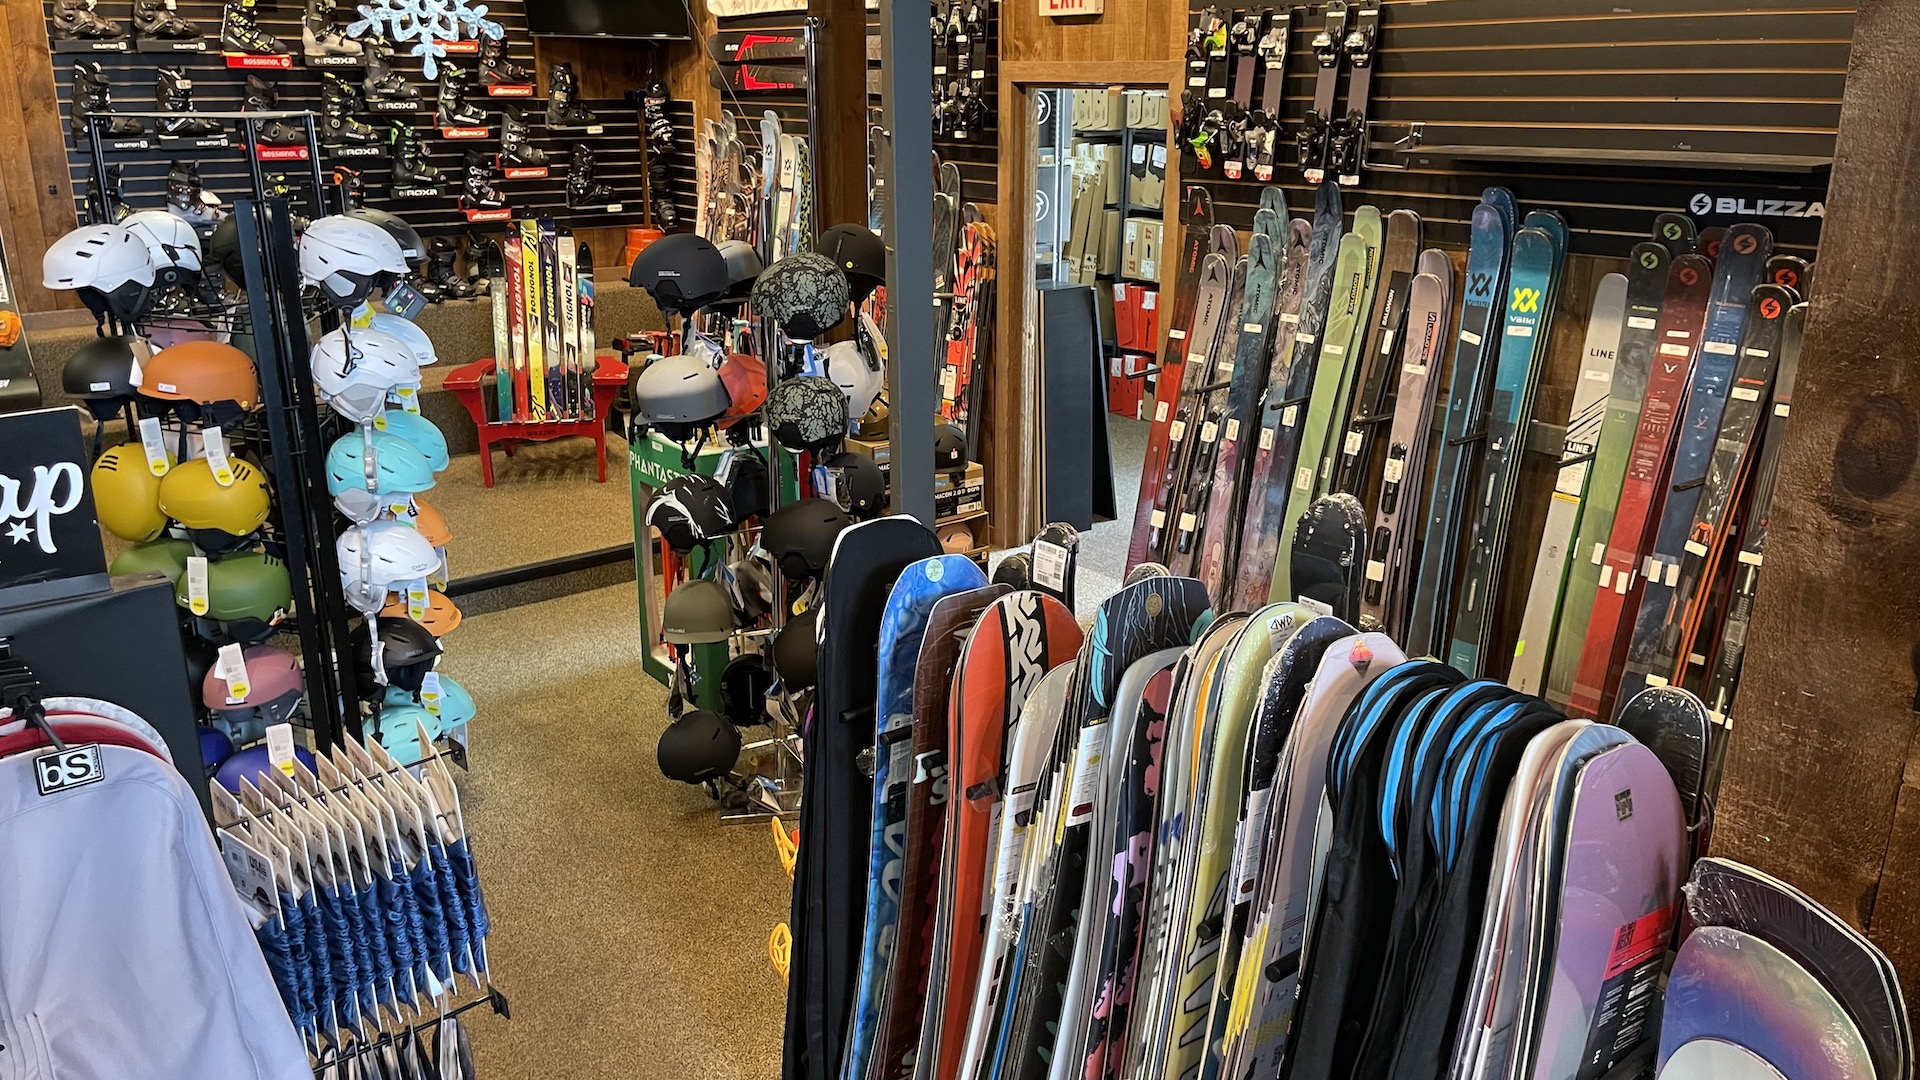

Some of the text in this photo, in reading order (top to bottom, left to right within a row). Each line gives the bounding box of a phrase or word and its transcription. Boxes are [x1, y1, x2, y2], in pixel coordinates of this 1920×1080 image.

[243, 58, 280, 66] ROSSIGNOL
[323, 57, 357, 65] ROXA
[386, 101, 418, 110] ROXA
[262, 150, 298, 159] ROSSIGNOL
[346, 147, 380, 156] ROXA
[406, 187, 438, 197] ROXA
[1189, 240, 1199, 273] ATOMIC
[1318, 231, 1329, 265] ATOMIC
[528, 261, 537, 313] ROSSIGNOL
[1292, 263, 1302, 296] ATOMIC
[544, 265, 554, 324] ROSSIGNOL
[1253, 283, 1262, 314] ATOMIC
[1348, 274, 1360, 313] SALOMON
[1203, 293, 1214, 326] ATOMIC
[1381, 288, 1395, 326] SALOMON
[1510, 315, 1536, 325] Völkl
[1590, 348, 1615, 360] LINE
[1566, 441, 1590, 453] LINE
